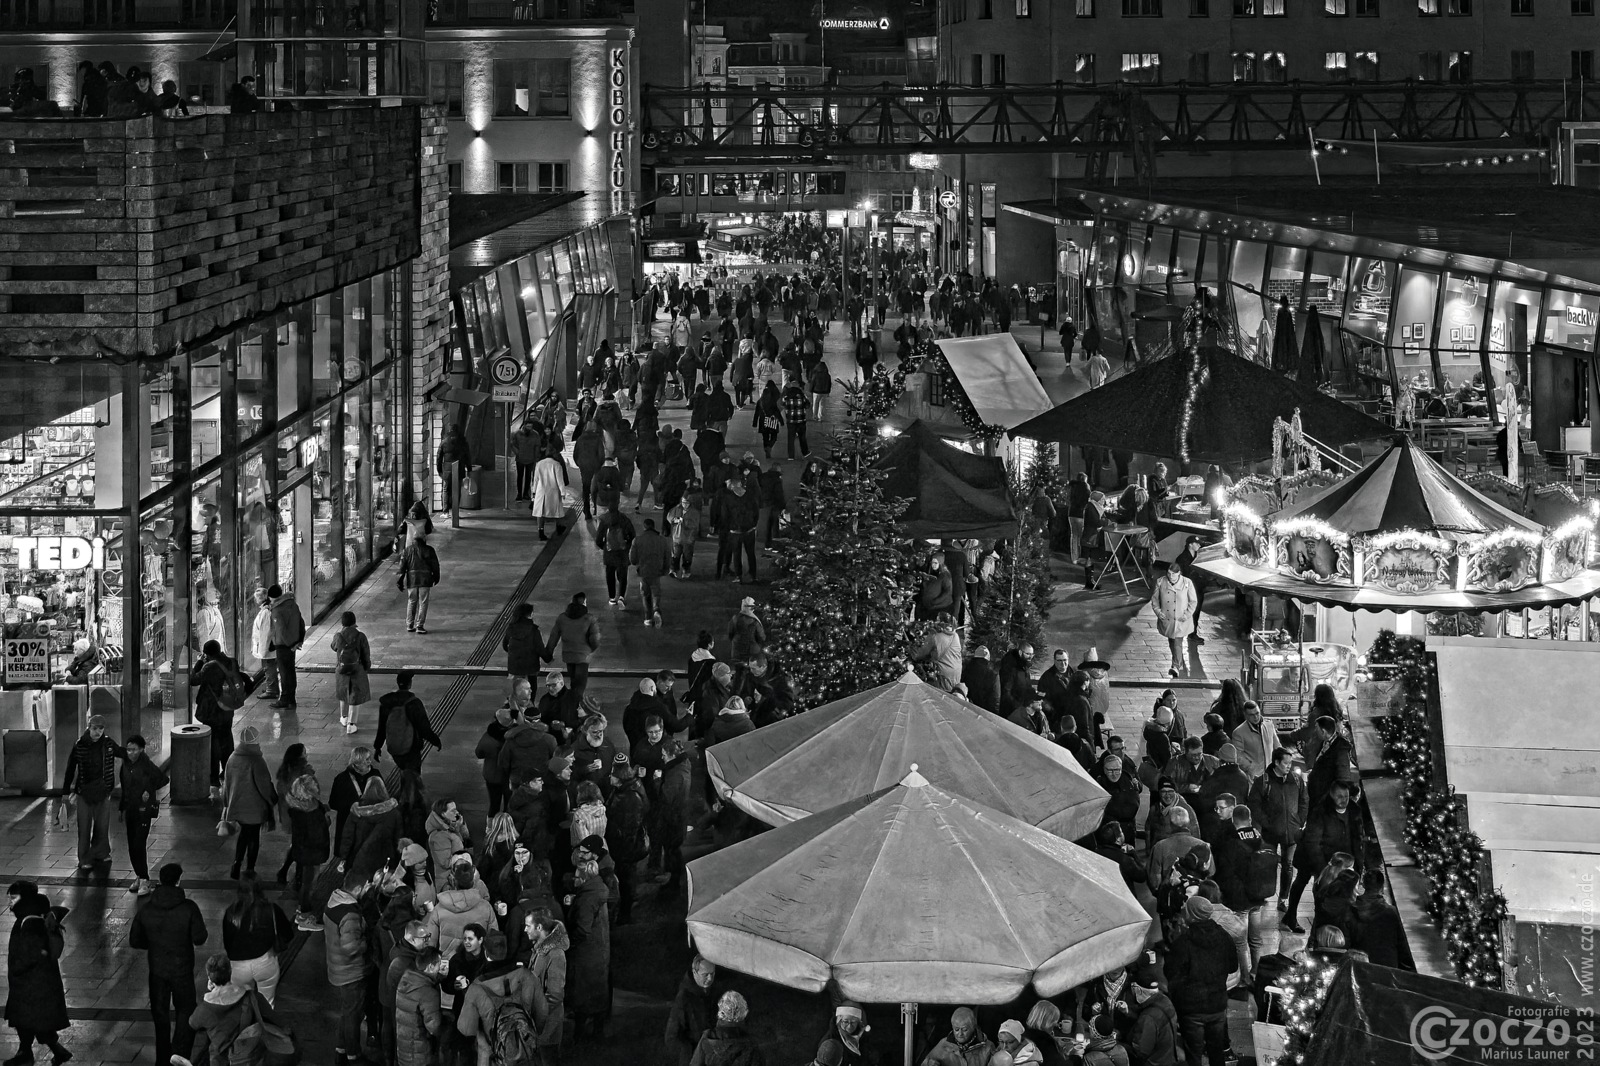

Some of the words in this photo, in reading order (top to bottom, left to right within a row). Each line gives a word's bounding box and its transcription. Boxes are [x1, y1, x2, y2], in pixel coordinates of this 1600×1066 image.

[820, 20, 878, 29] COMMERZBANK
[1567, 307, 1587, 325] back
[12, 536, 105, 570] TEDi
[8, 641, 46, 657] 30%
